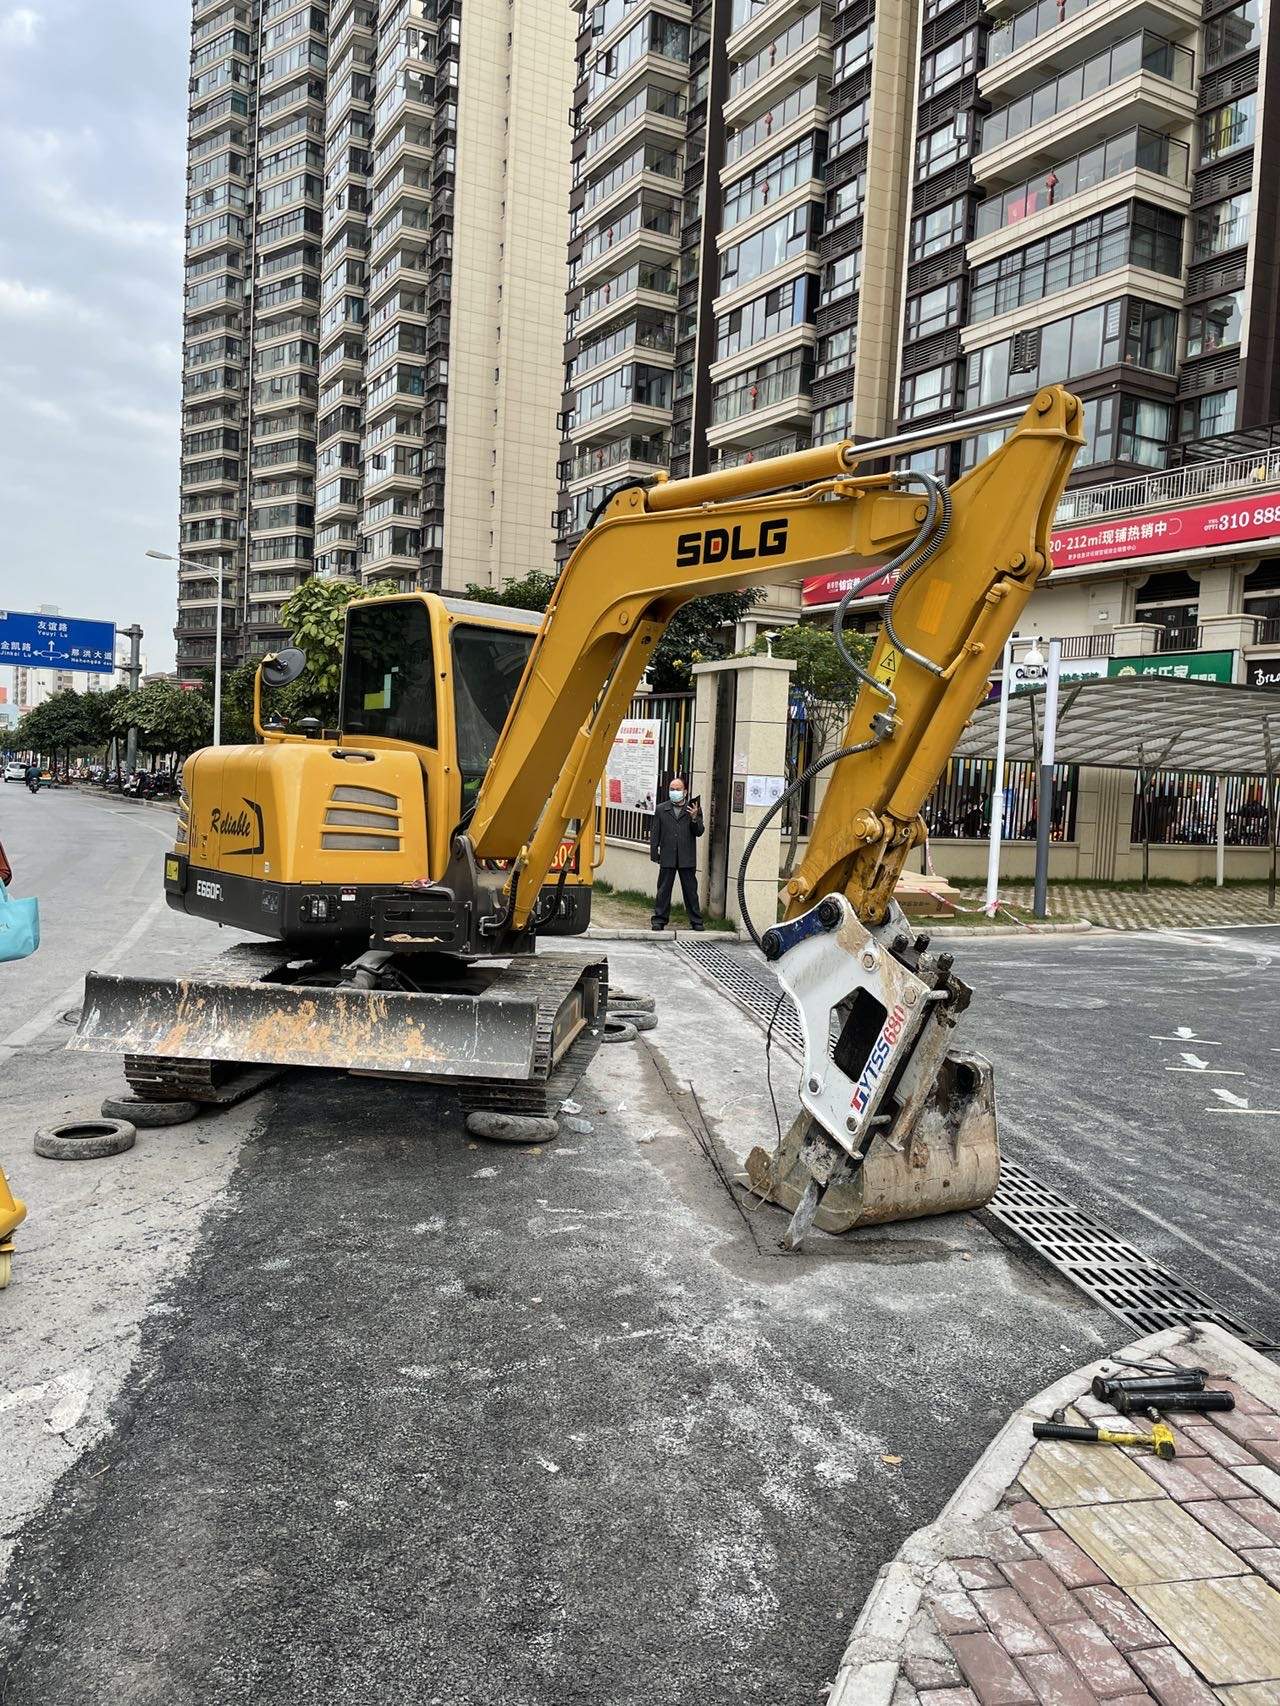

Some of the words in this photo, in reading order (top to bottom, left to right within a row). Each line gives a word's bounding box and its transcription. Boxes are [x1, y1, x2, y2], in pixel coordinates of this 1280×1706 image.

[1218, 511, 1250, 531] 310
[676, 518, 788, 567] SDLG
[37, 620, 68, 631] 友谊路
[210, 807, 252, 838] Reliable
